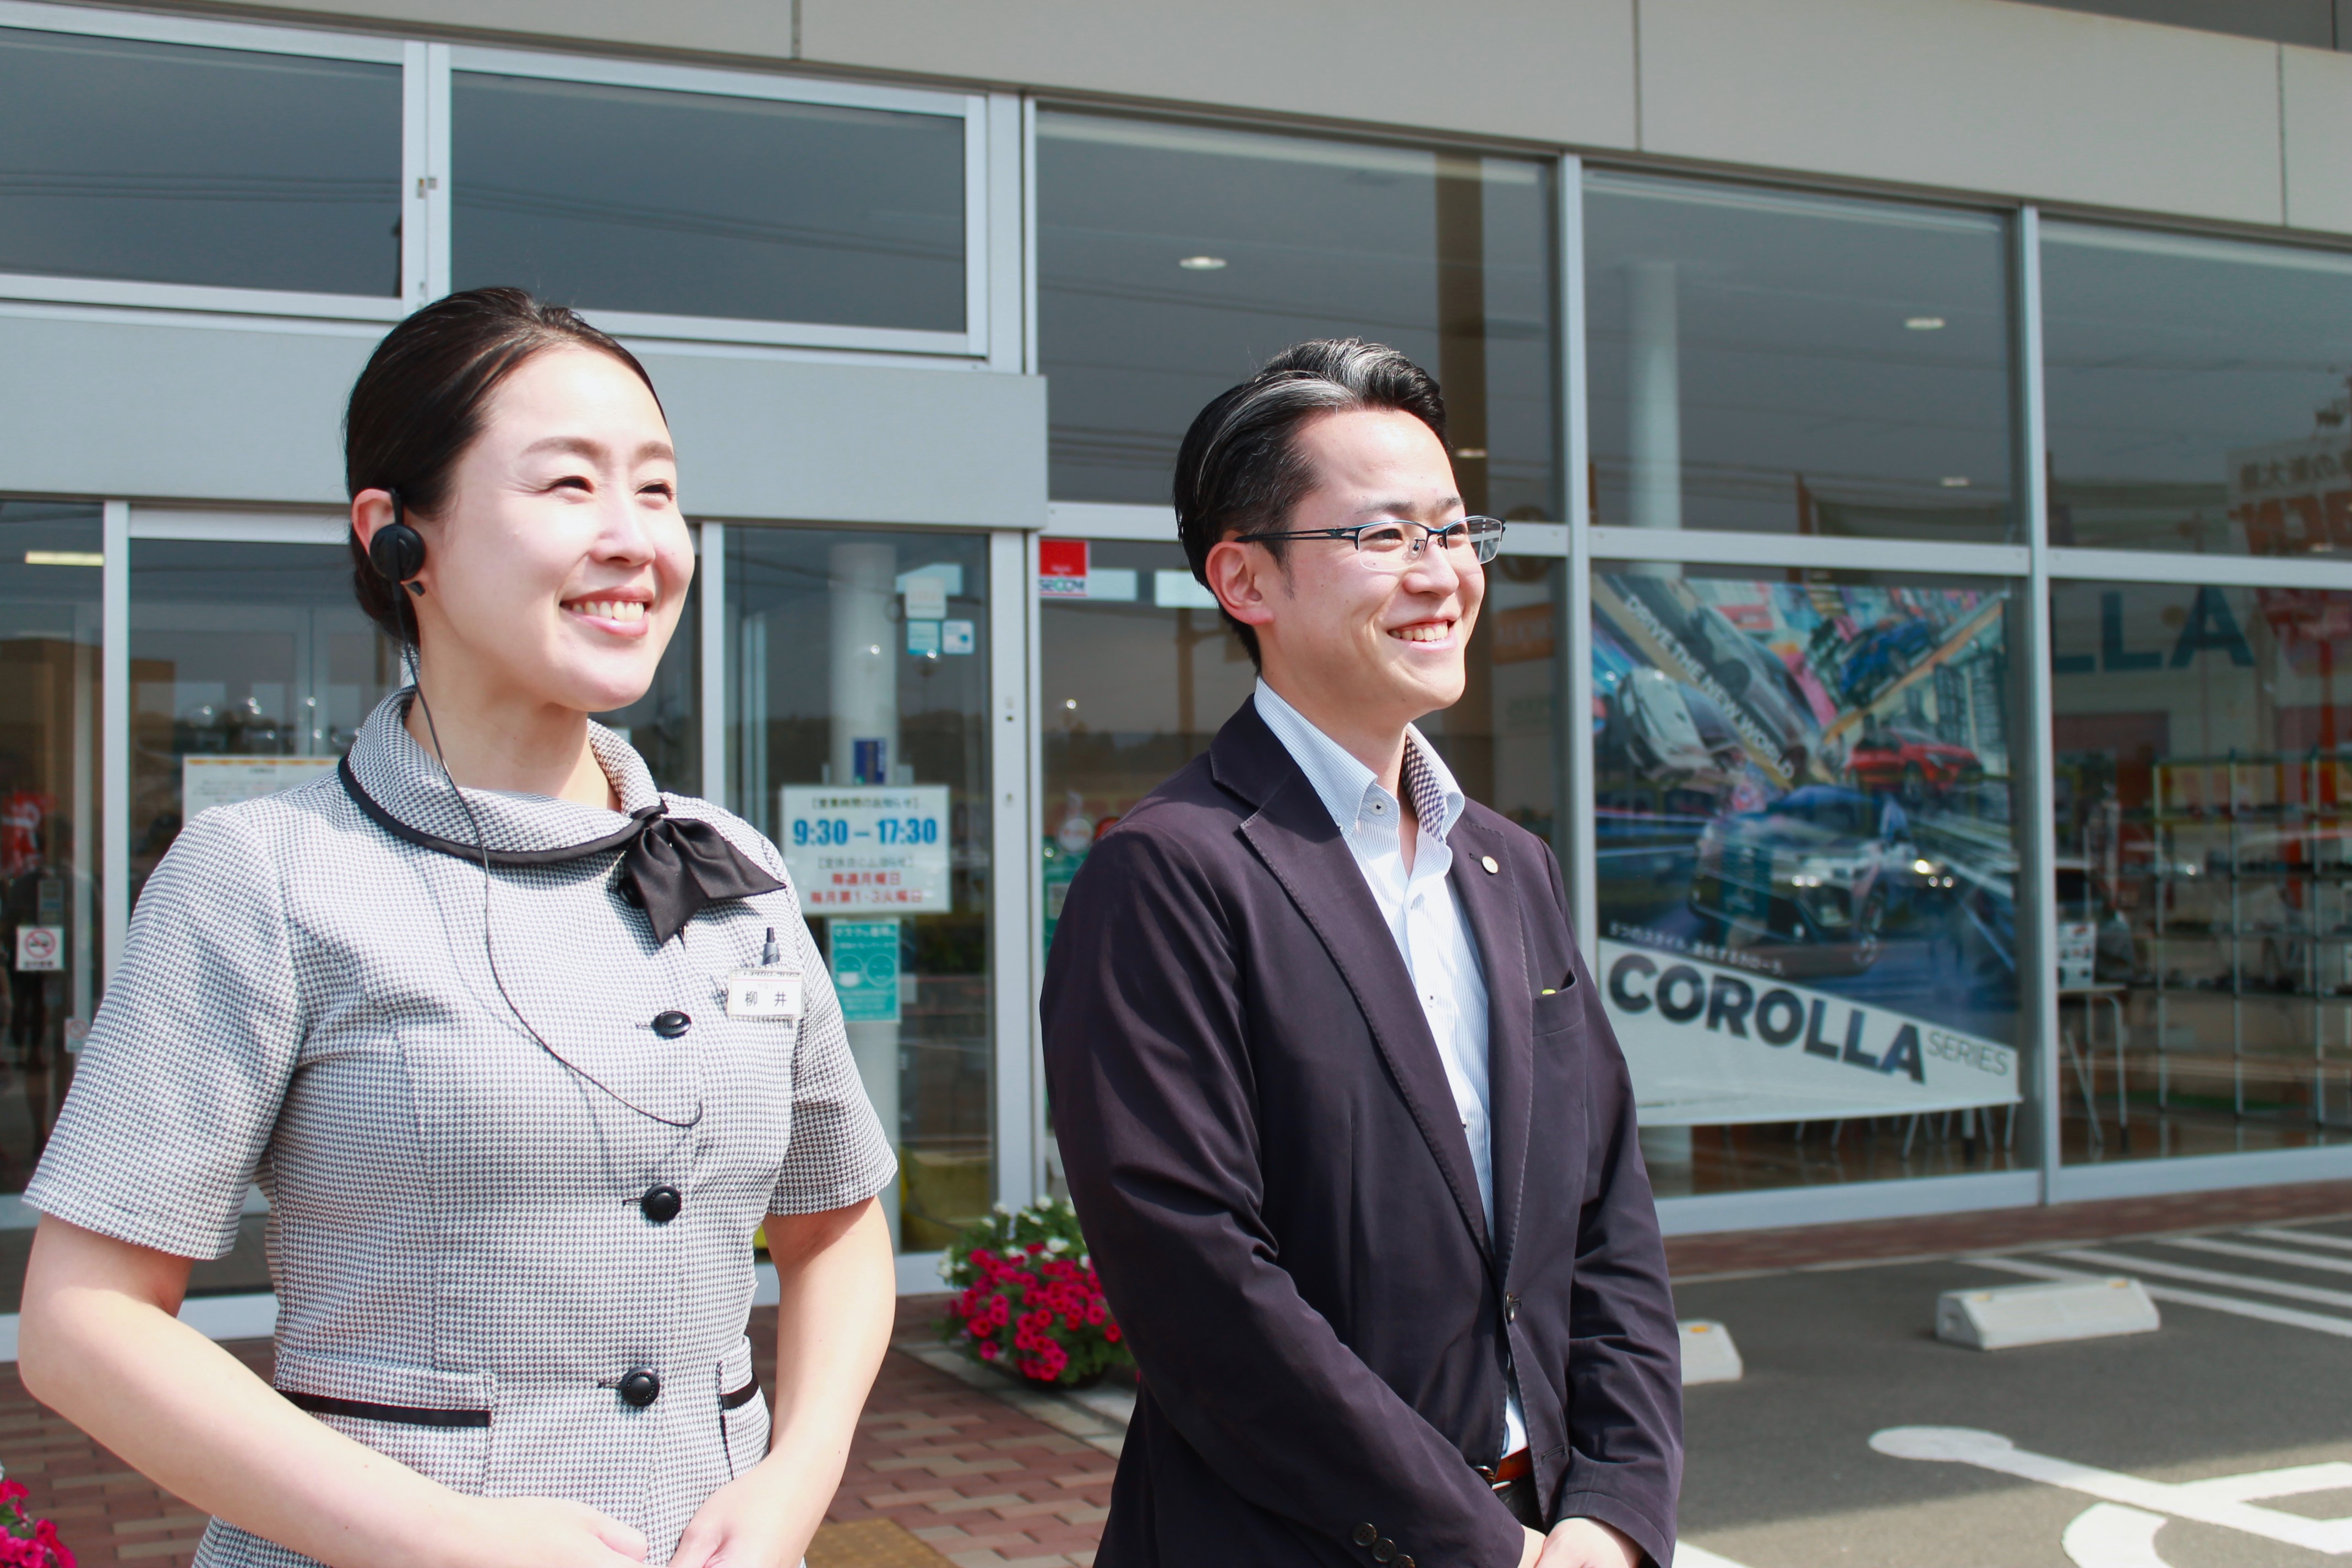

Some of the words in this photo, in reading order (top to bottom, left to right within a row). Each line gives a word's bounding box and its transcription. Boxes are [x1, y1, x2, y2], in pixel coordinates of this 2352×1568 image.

[1038, 578, 1085, 591] SECOM
[1625, 594, 1676, 650] DRIVE
[1668, 640, 1706, 682] THE
[1698, 674, 1744, 721] NEW
[1736, 715, 1795, 779] WORLD
[793, 819, 848, 846] 9:30
[876, 818, 937, 845] 17:30
[1608, 953, 1925, 1084] COROLLA
[1928, 1030, 2009, 1076] SERIES
